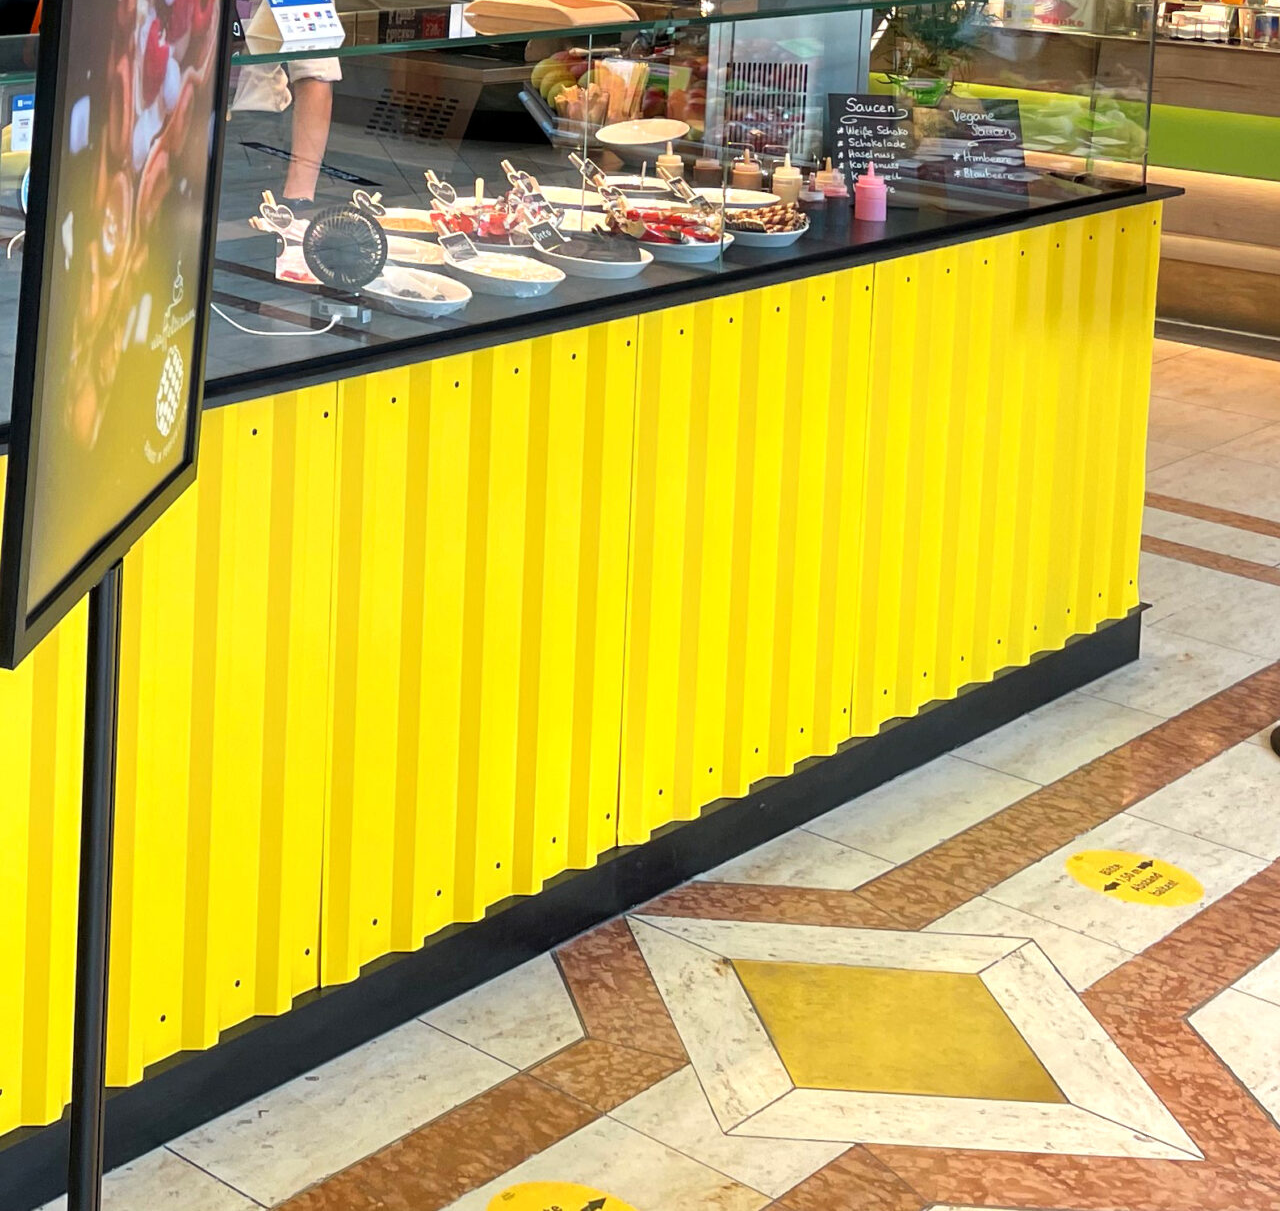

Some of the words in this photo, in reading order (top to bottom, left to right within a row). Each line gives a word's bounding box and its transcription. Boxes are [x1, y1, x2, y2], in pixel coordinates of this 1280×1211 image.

[846, 98, 895, 113] Saucen
[950, 109, 995, 125] Vegane
[877, 126, 908, 136] Schoko
[848, 139, 907, 149] Schokolade
[848, 150, 895, 159] Haselnuss
[849, 161, 900, 170] Koksnuss
